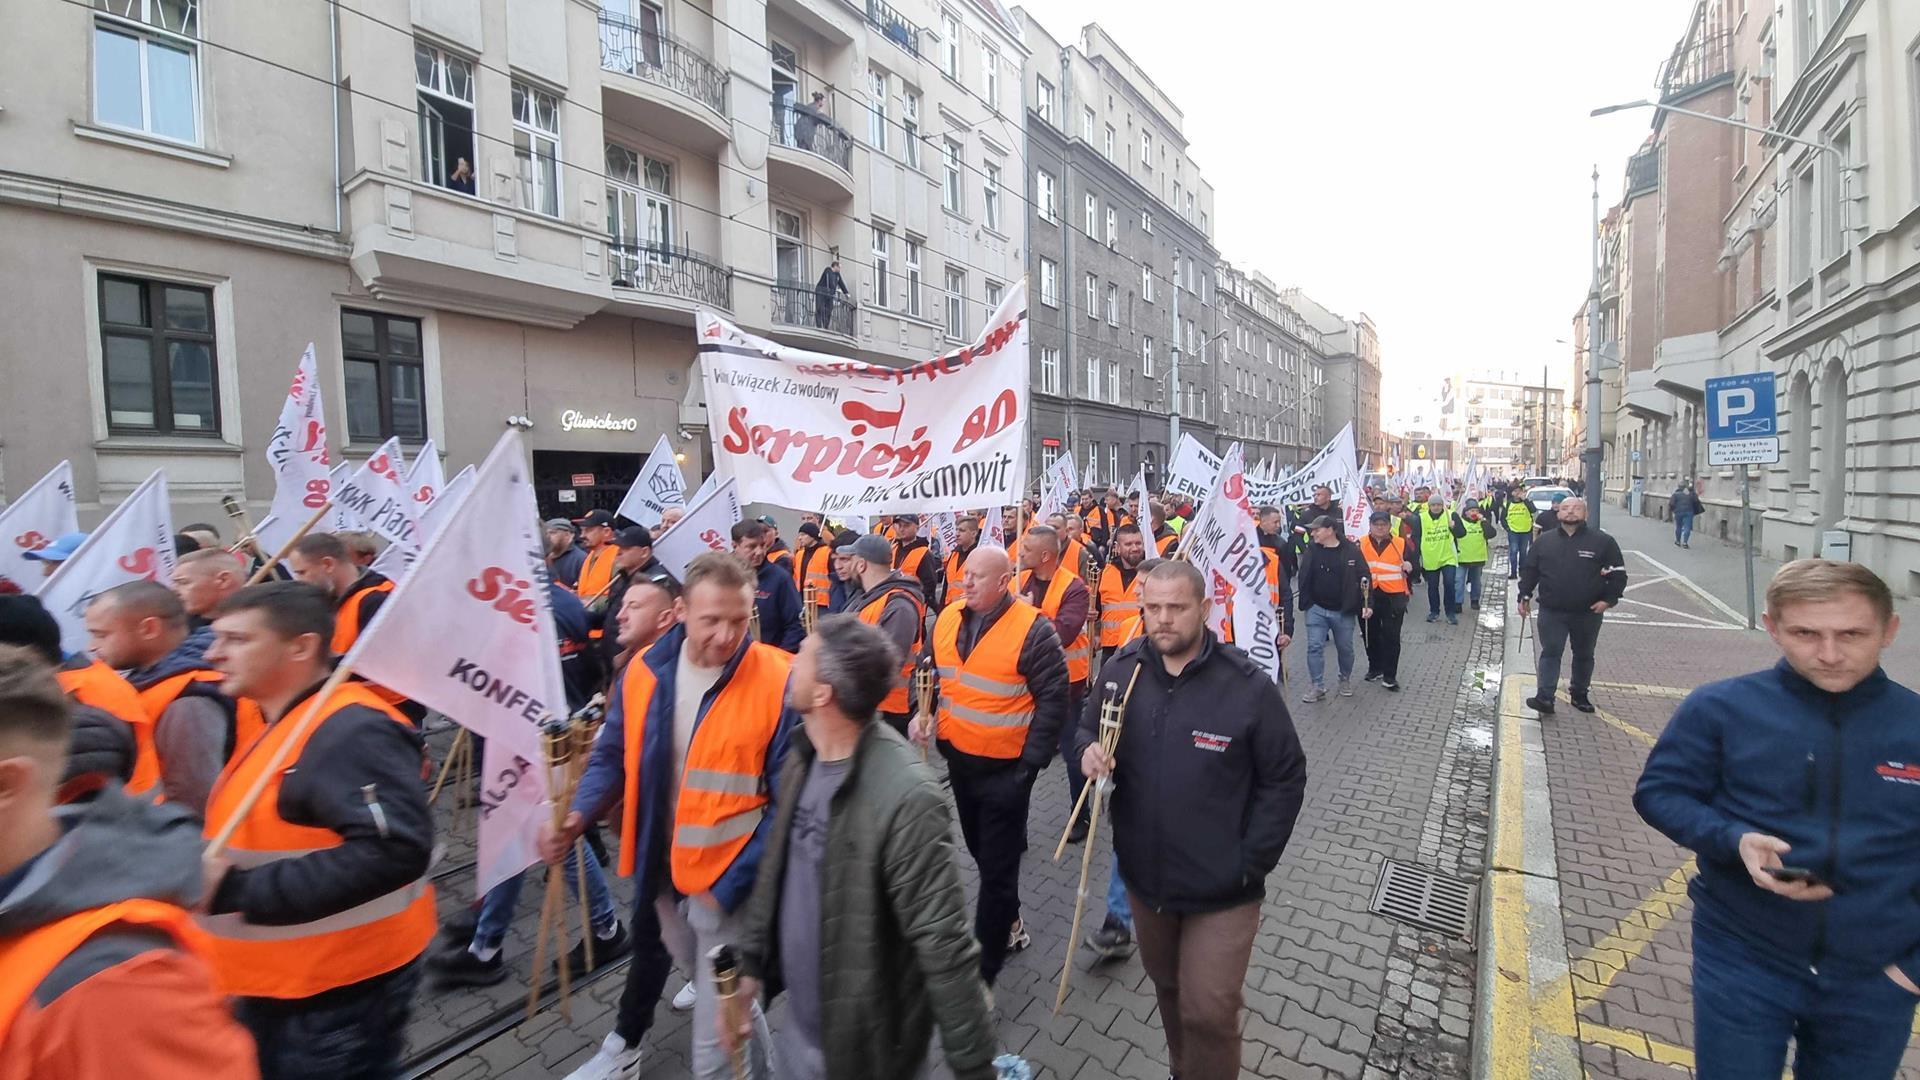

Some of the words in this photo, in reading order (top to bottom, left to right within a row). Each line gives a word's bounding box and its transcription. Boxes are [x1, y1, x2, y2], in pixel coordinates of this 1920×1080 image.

[731, 370, 780, 393] Związek
[782, 378, 840, 404] Zawodowy
[1717, 387, 1755, 427] P
[952, 388, 1017, 454] 80
[335, 484, 376, 514] KWK
[1203, 514, 1226, 554] KWK
